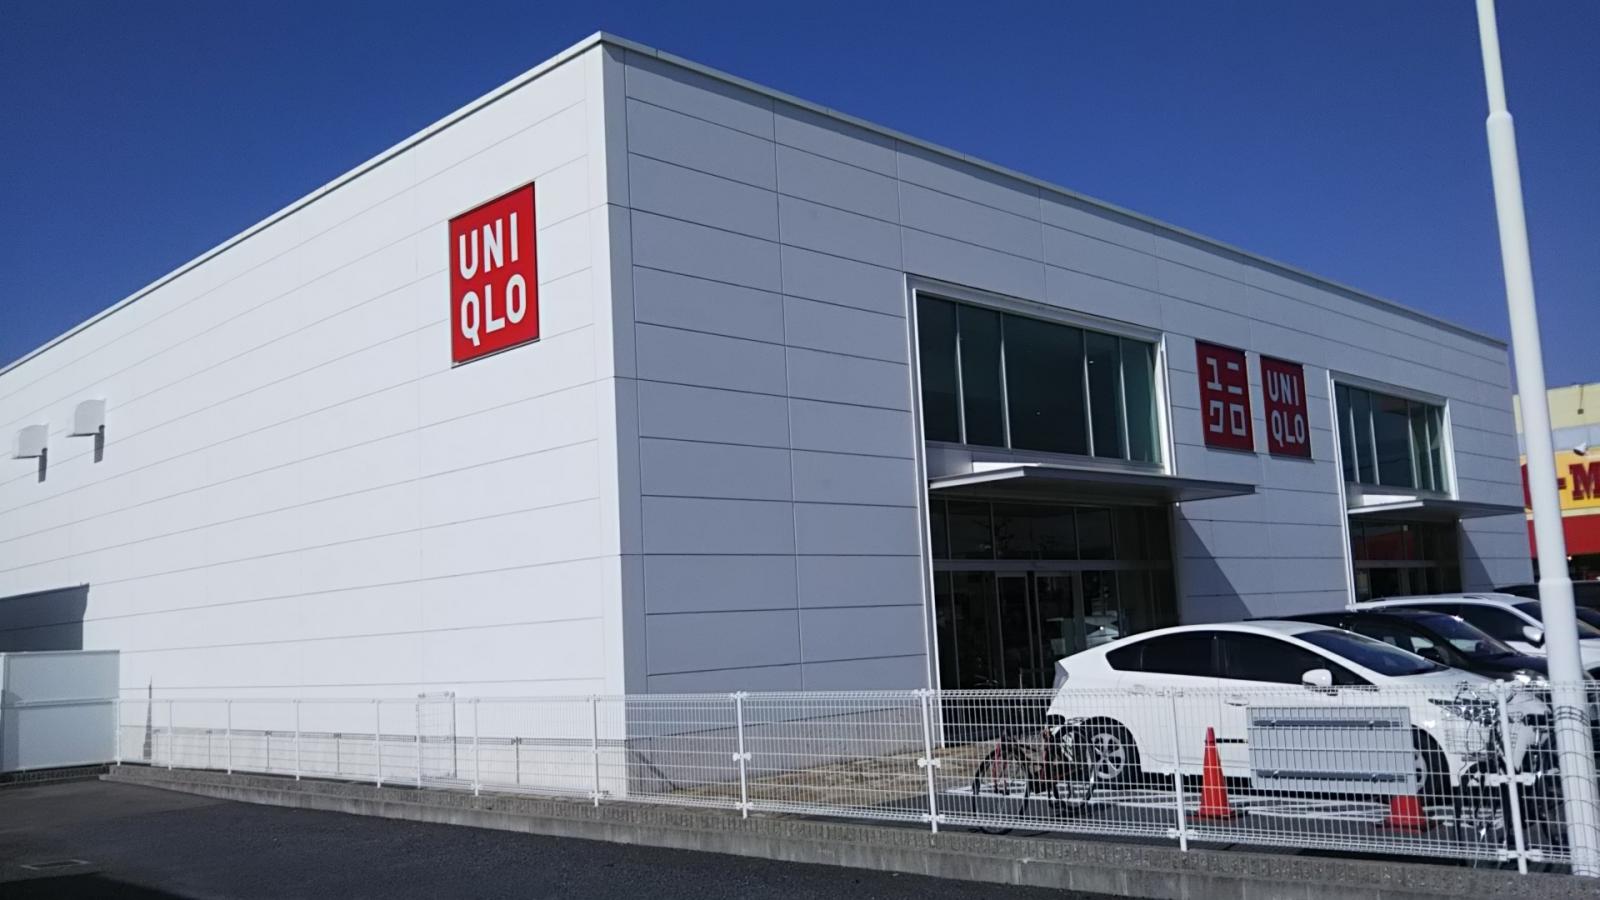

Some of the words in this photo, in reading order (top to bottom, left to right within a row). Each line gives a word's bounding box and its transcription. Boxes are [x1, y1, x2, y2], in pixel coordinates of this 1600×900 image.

[459, 212, 519, 280] UNI
[460, 273, 527, 347] QLO
[1206, 357, 1243, 395] ユニ
[1267, 369, 1300, 407] UNI
[1209, 399, 1247, 437] クロ
[1271, 410, 1306, 448] QLO
